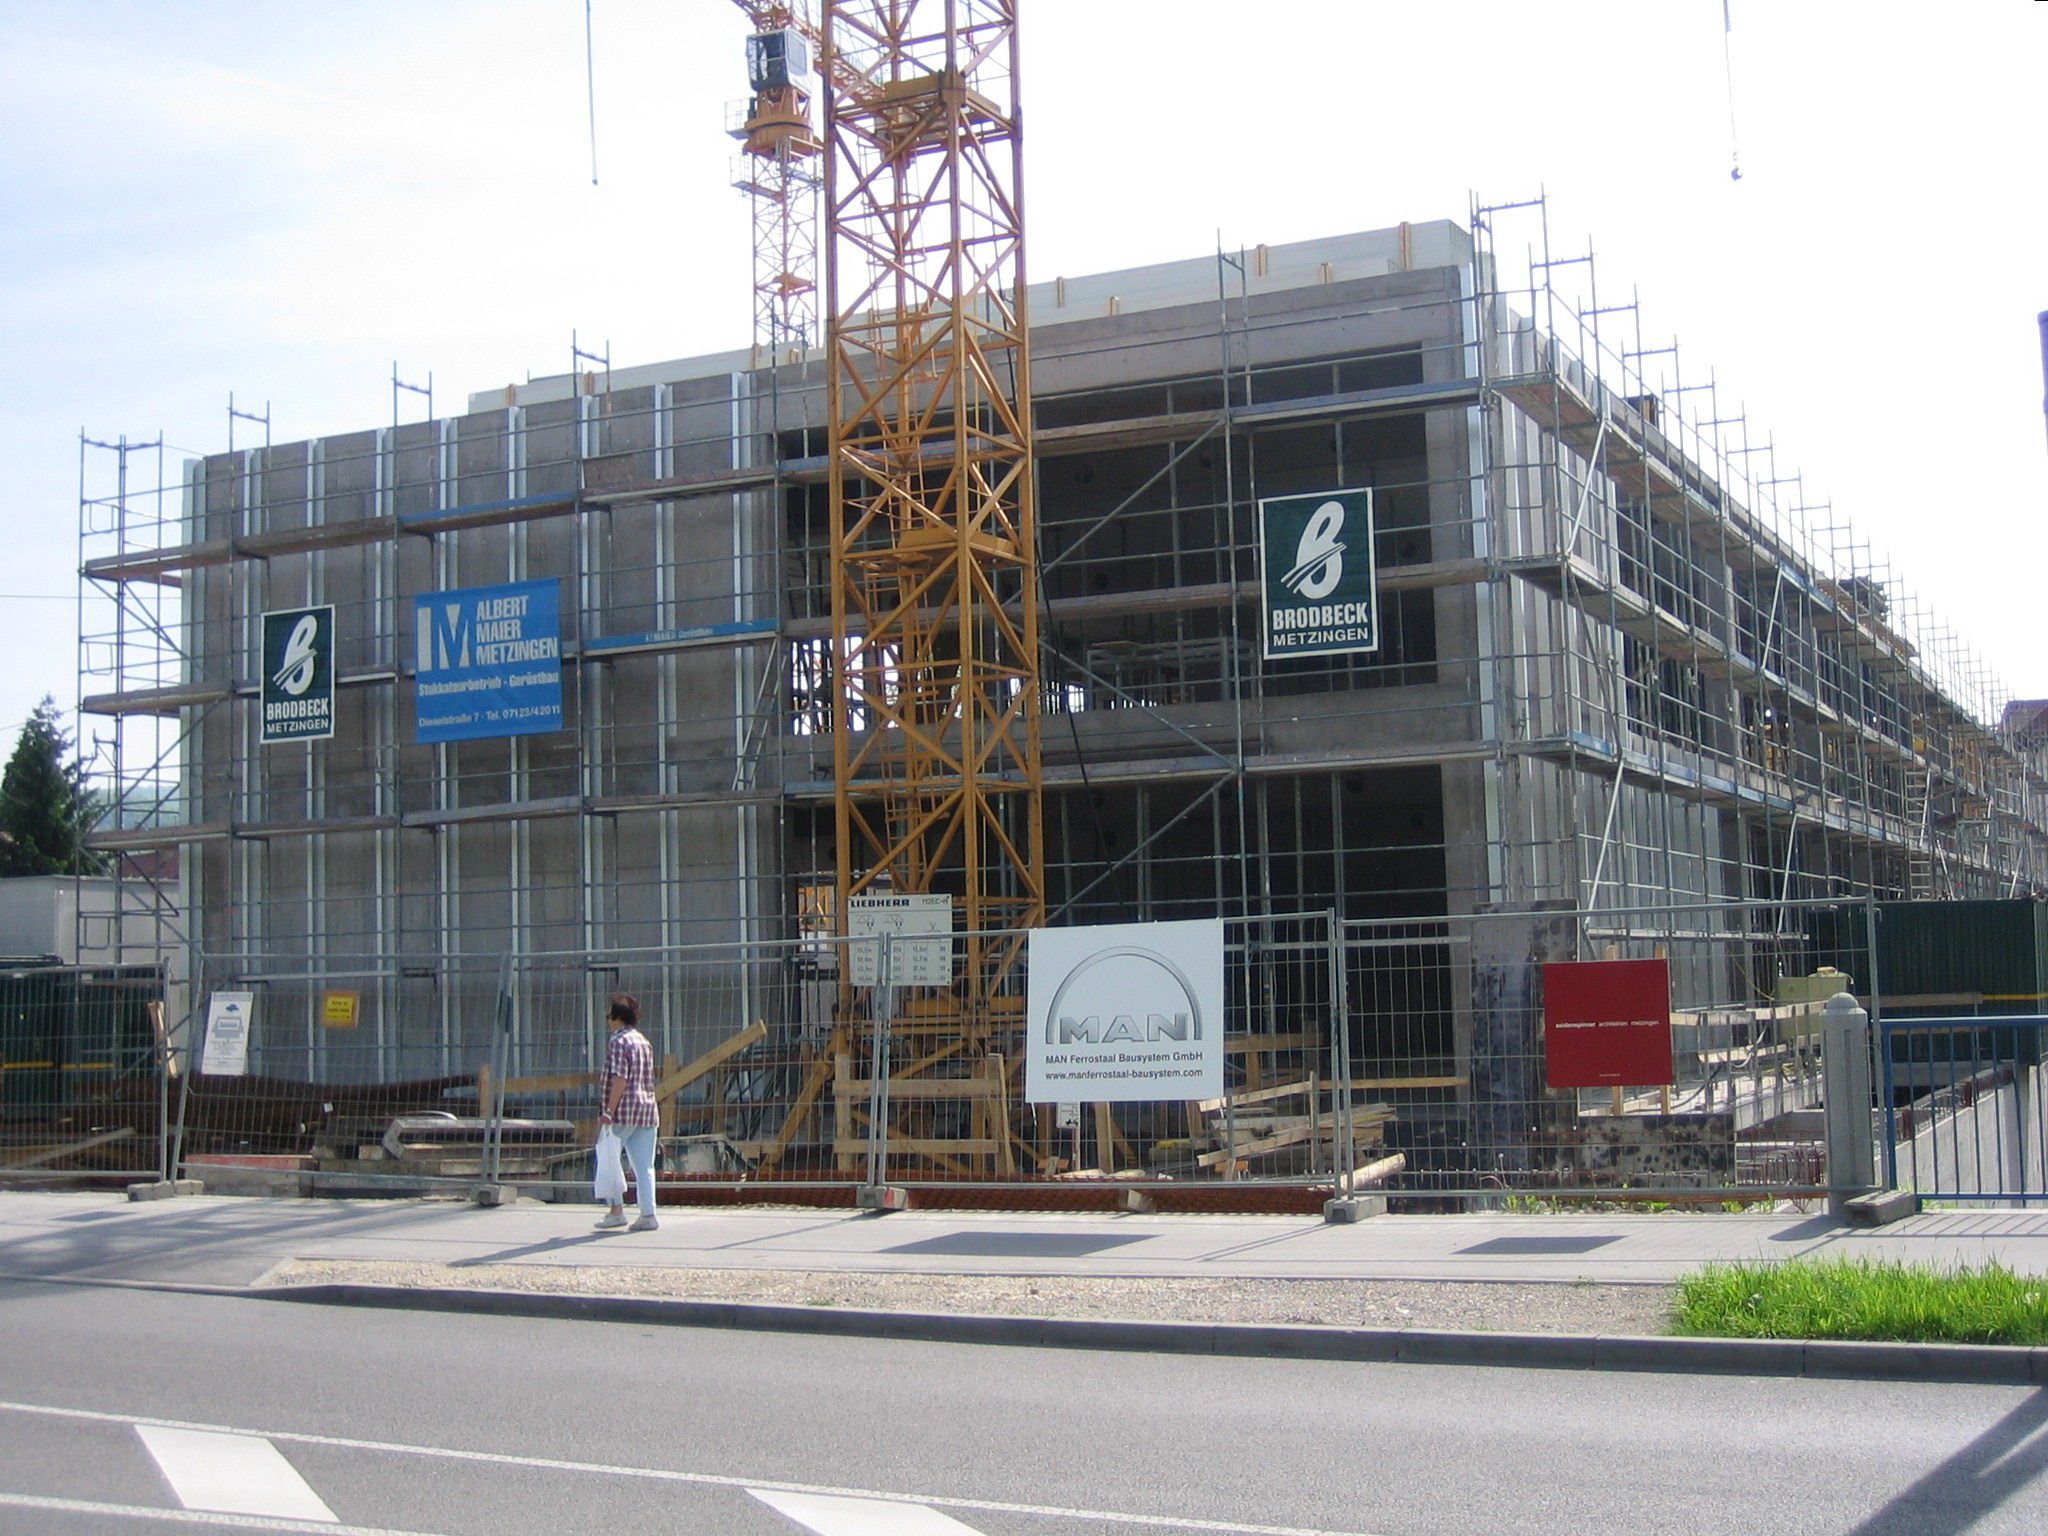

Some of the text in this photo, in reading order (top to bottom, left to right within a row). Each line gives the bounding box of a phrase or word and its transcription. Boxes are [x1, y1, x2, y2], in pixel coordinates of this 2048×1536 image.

[476, 595, 529, 622] ALBERT
[1272, 602, 1369, 631] BRODBECK
[476, 619, 522, 645] MAIER
[1273, 627, 1369, 647] METZINGEN
[476, 637, 559, 666] METZINGEN
[266, 697, 329, 720] BRODBECK
[266, 718, 329, 733] METZINGEN
[850, 898, 910, 908] LIEBHERR
[1059, 1013, 1188, 1045] MAN
[1045, 1051, 1204, 1065] MAN Ferrostaal Bausystem GmbH
[1045, 1069, 1204, 1081] www.manferrostaal-bausystem.com
